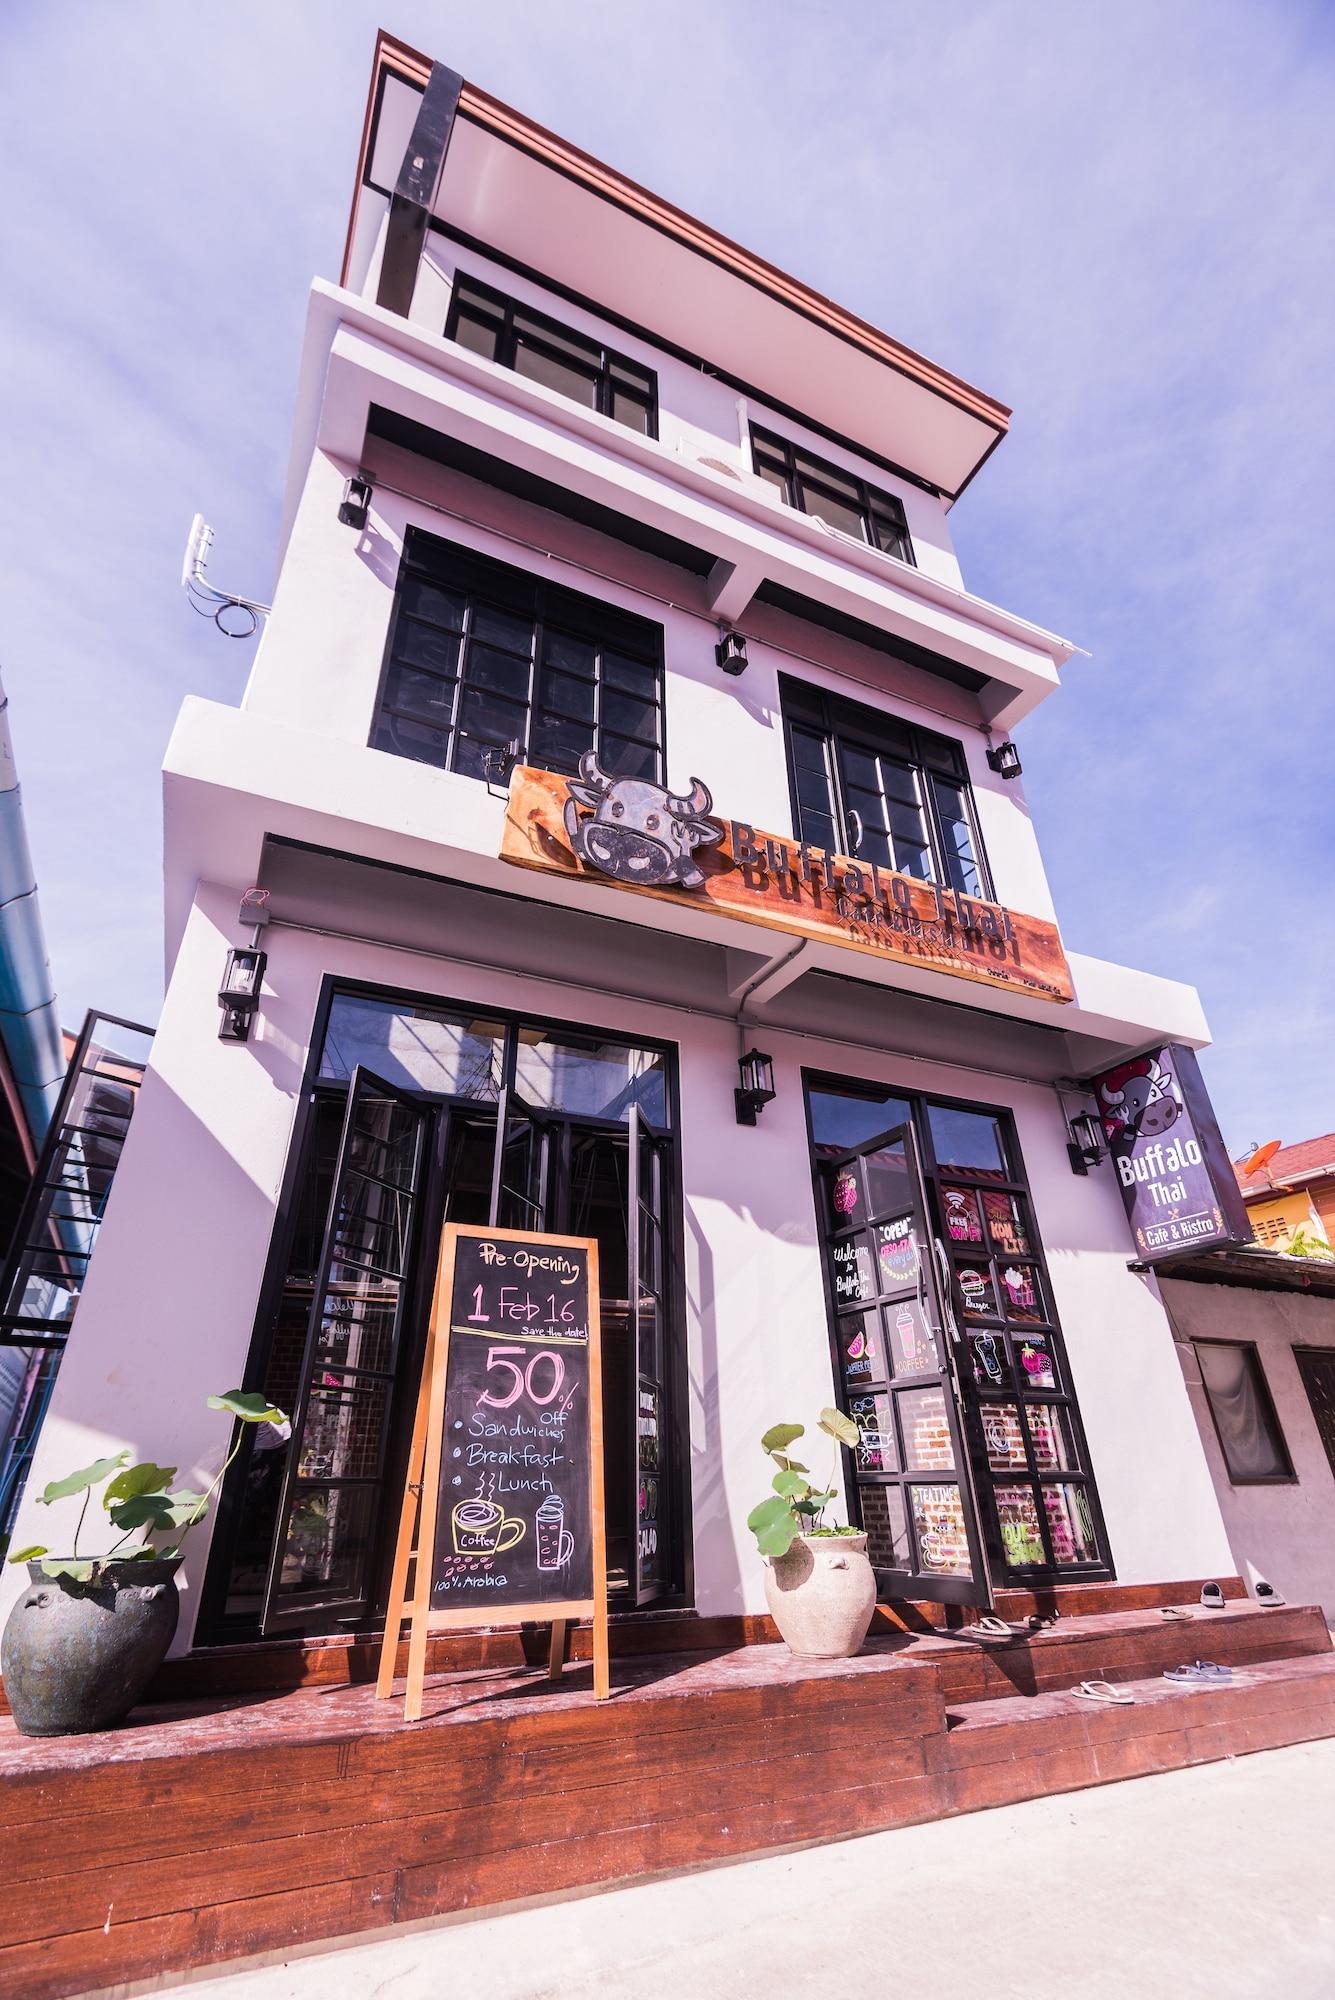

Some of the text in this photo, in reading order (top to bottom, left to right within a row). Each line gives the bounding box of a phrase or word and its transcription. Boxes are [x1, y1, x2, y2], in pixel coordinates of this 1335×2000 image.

[731, 820, 1016, 941] Buffalo Thai
[1117, 1137, 1203, 1187] Buffalo
[1147, 1175, 1188, 1207] Thai
[1170, 1224, 1181, 1240] &
[1180, 1218, 1214, 1237] Bistro
[478, 1242, 580, 1284] Pre-Opening
[833, 1243, 869, 1261] Welcome
[467, 1284, 575, 1323] 1 Feb 16
[547, 1326, 563, 1338] the
[898, 1357, 925, 1374] COFFEE
[468, 1412, 566, 1443] Sandwiches
[540, 1411, 569, 1427] Off
[466, 1443, 565, 1468] Breakfast
[498, 1471, 554, 1493] Lunch
[460, 1531, 496, 1548] Coffee
[462, 1573, 508, 1590] Arabica
